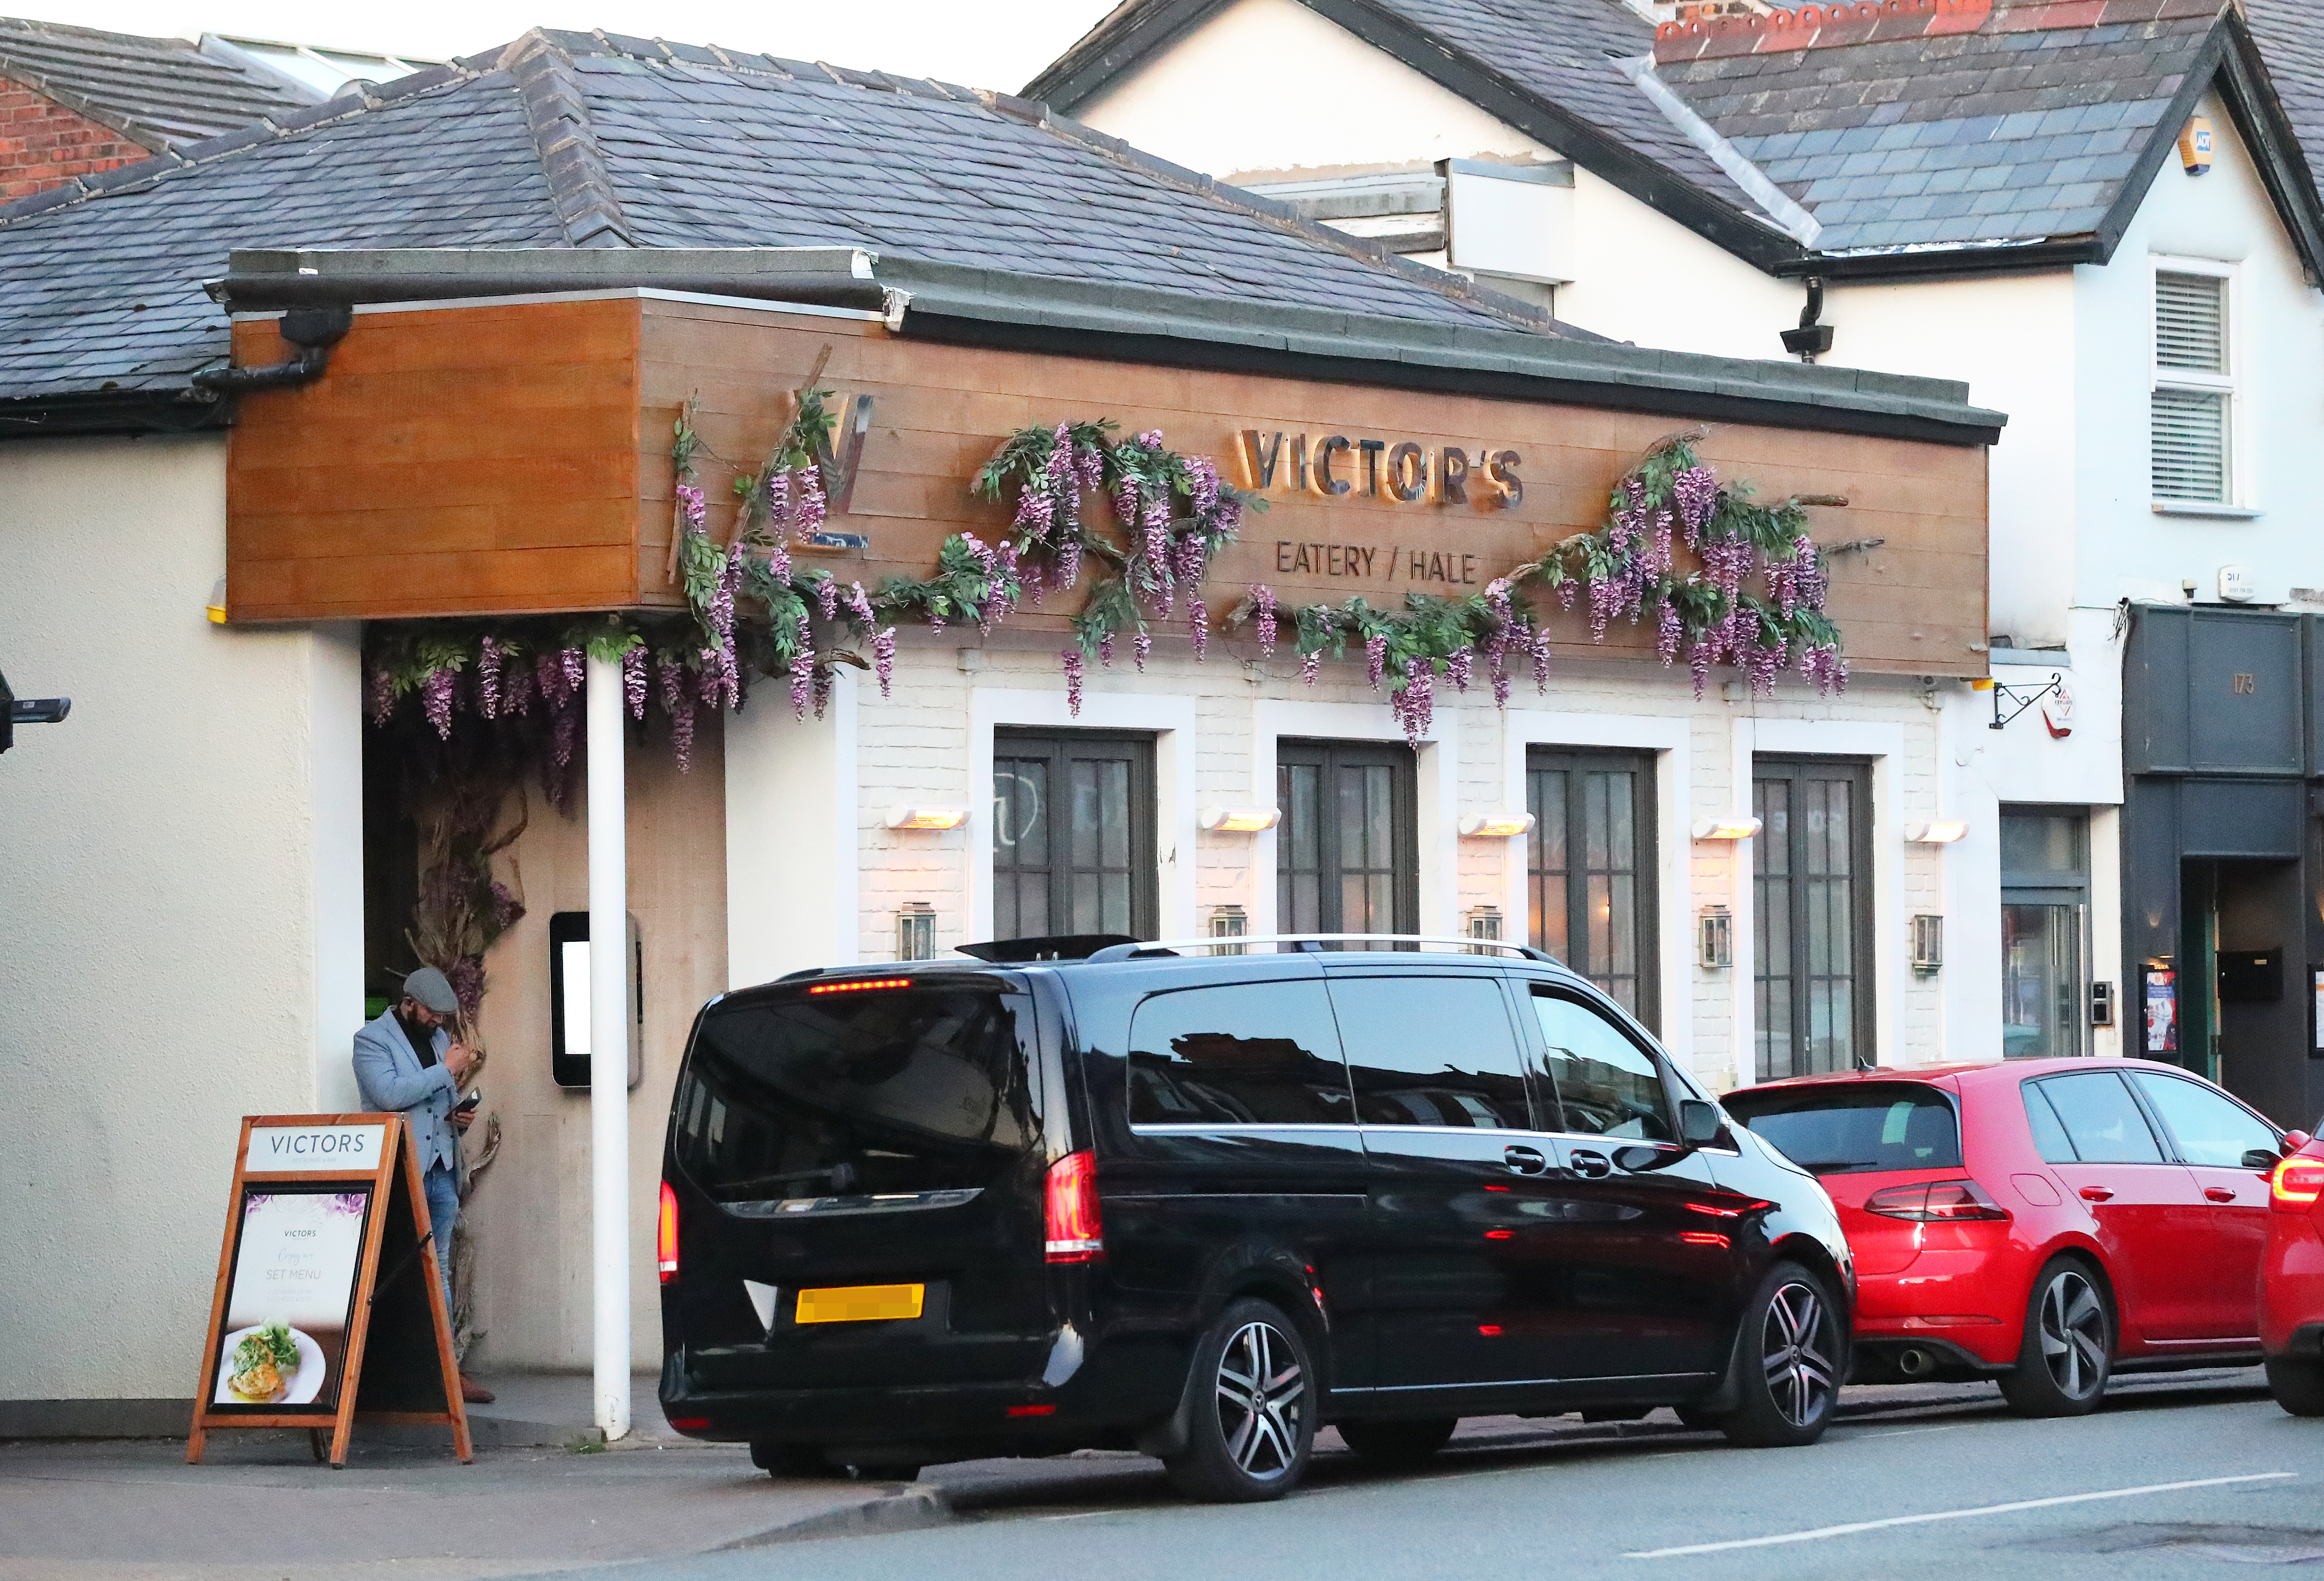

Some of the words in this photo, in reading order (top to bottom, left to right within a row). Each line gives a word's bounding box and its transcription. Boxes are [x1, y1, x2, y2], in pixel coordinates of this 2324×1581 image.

[2197, 135, 2210, 148] ADT
[1240, 429, 1523, 509] VICTOR'S
[1277, 541, 1377, 576] EATERY
[1389, 546, 1399, 581] /
[1410, 550, 1476, 584] HALE
[2233, 673, 2254, 694] 173
[271, 1134, 365, 1154] VICTORS
[266, 1269, 286, 1280] SET
[289, 1269, 321, 1279] MENU
